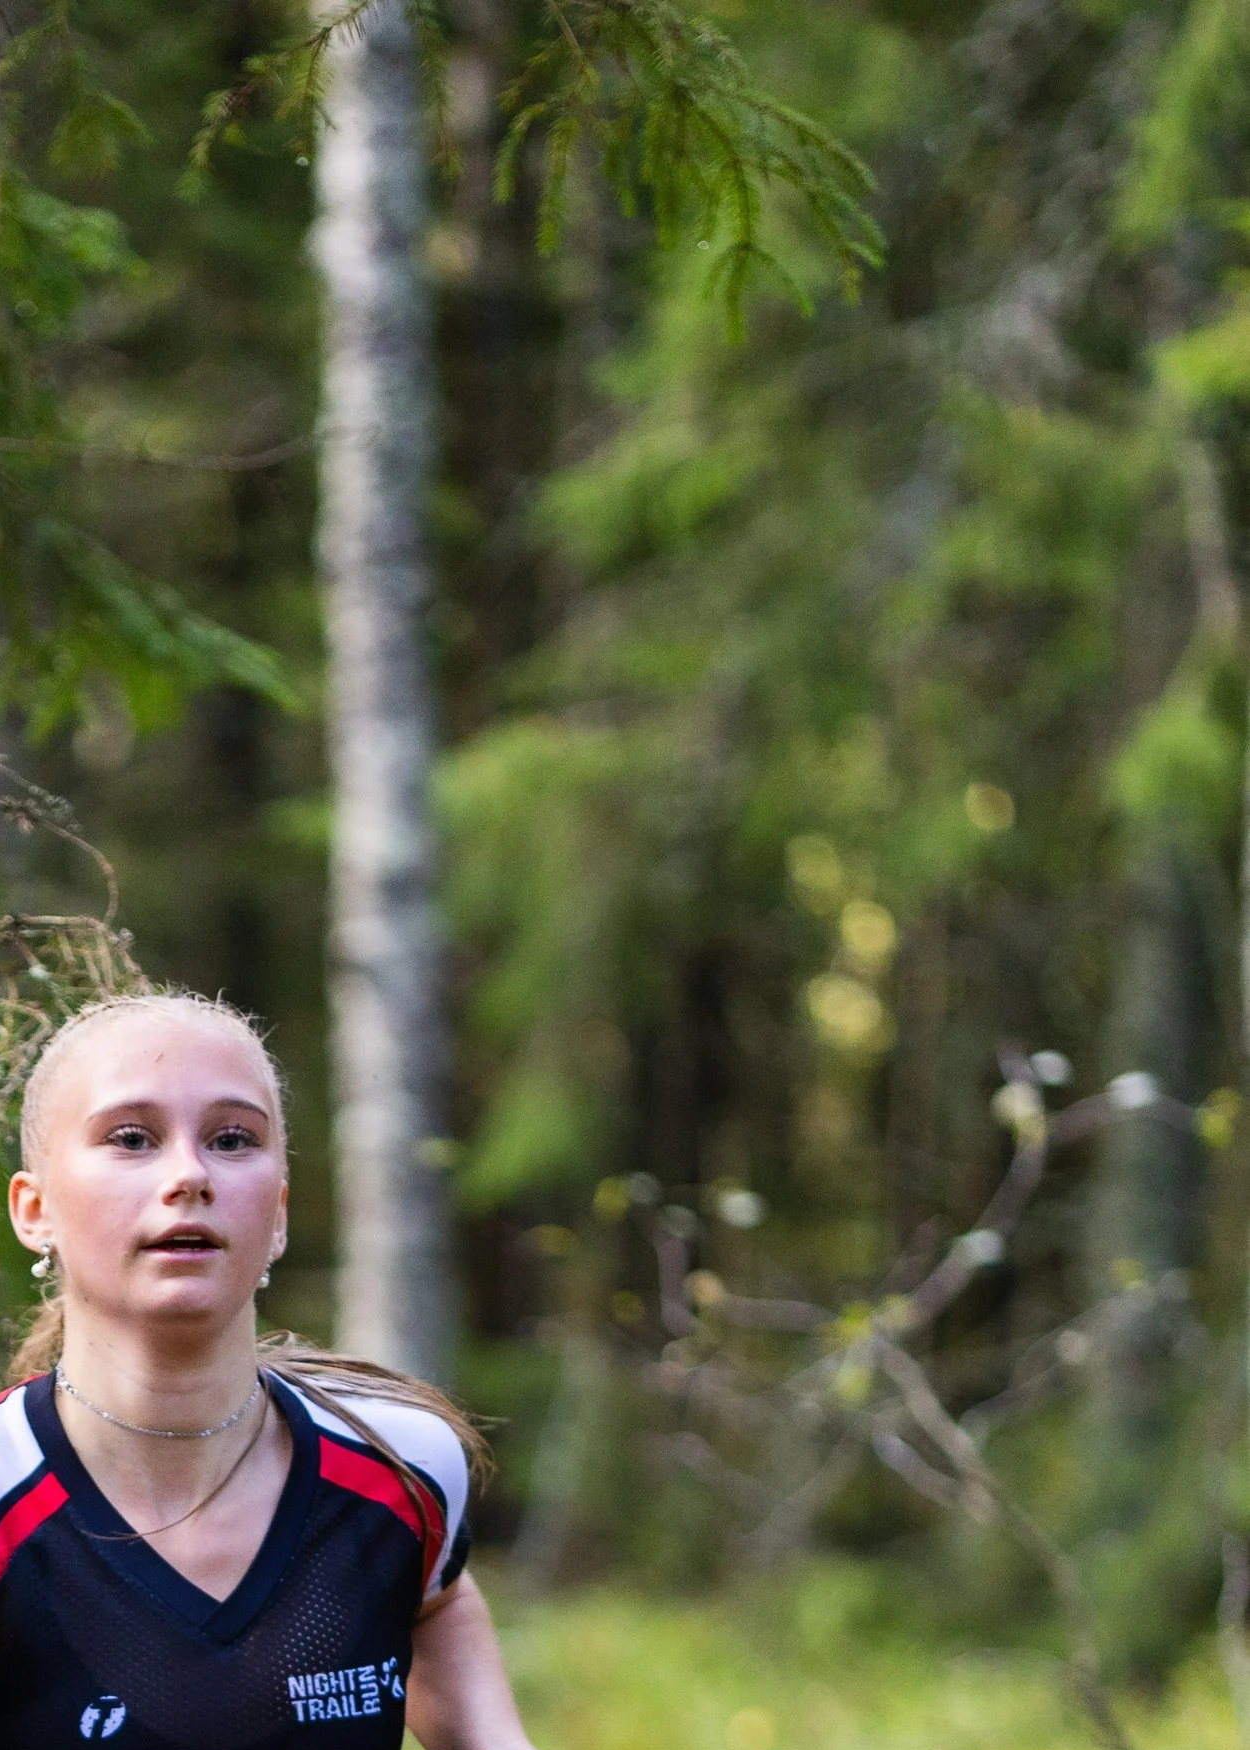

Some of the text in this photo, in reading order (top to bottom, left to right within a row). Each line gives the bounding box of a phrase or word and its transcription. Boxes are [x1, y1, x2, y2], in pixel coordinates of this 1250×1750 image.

[287, 1669, 356, 1699] NIGHT
[357, 1664, 381, 1714] RUN
[291, 1695, 363, 1722] TRAIL
